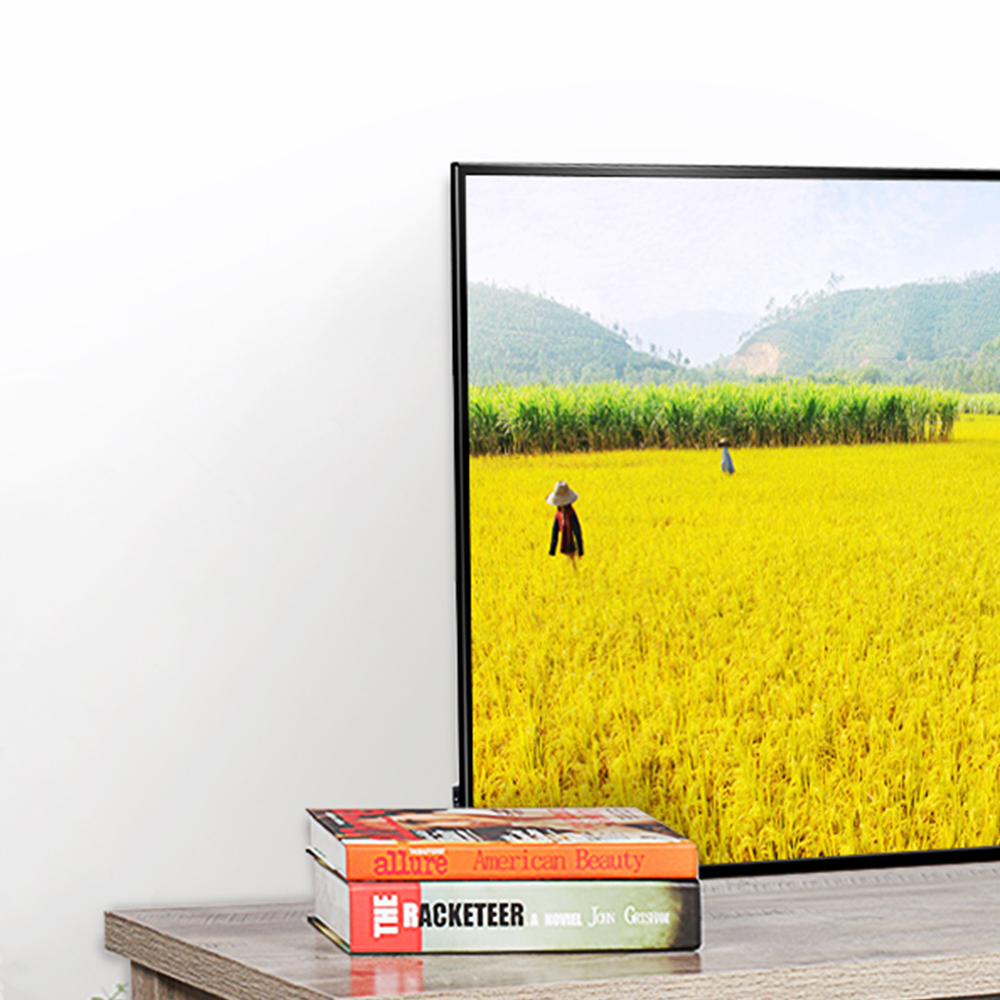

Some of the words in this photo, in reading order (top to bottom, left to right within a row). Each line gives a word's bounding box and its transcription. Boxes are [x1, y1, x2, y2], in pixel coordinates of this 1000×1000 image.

[373, 850, 448, 876] allure
[473, 849, 566, 871] American
[576, 848, 645, 873] Beauty
[373, 894, 398, 938] THE
[403, 902, 524, 928] RACKETEER
